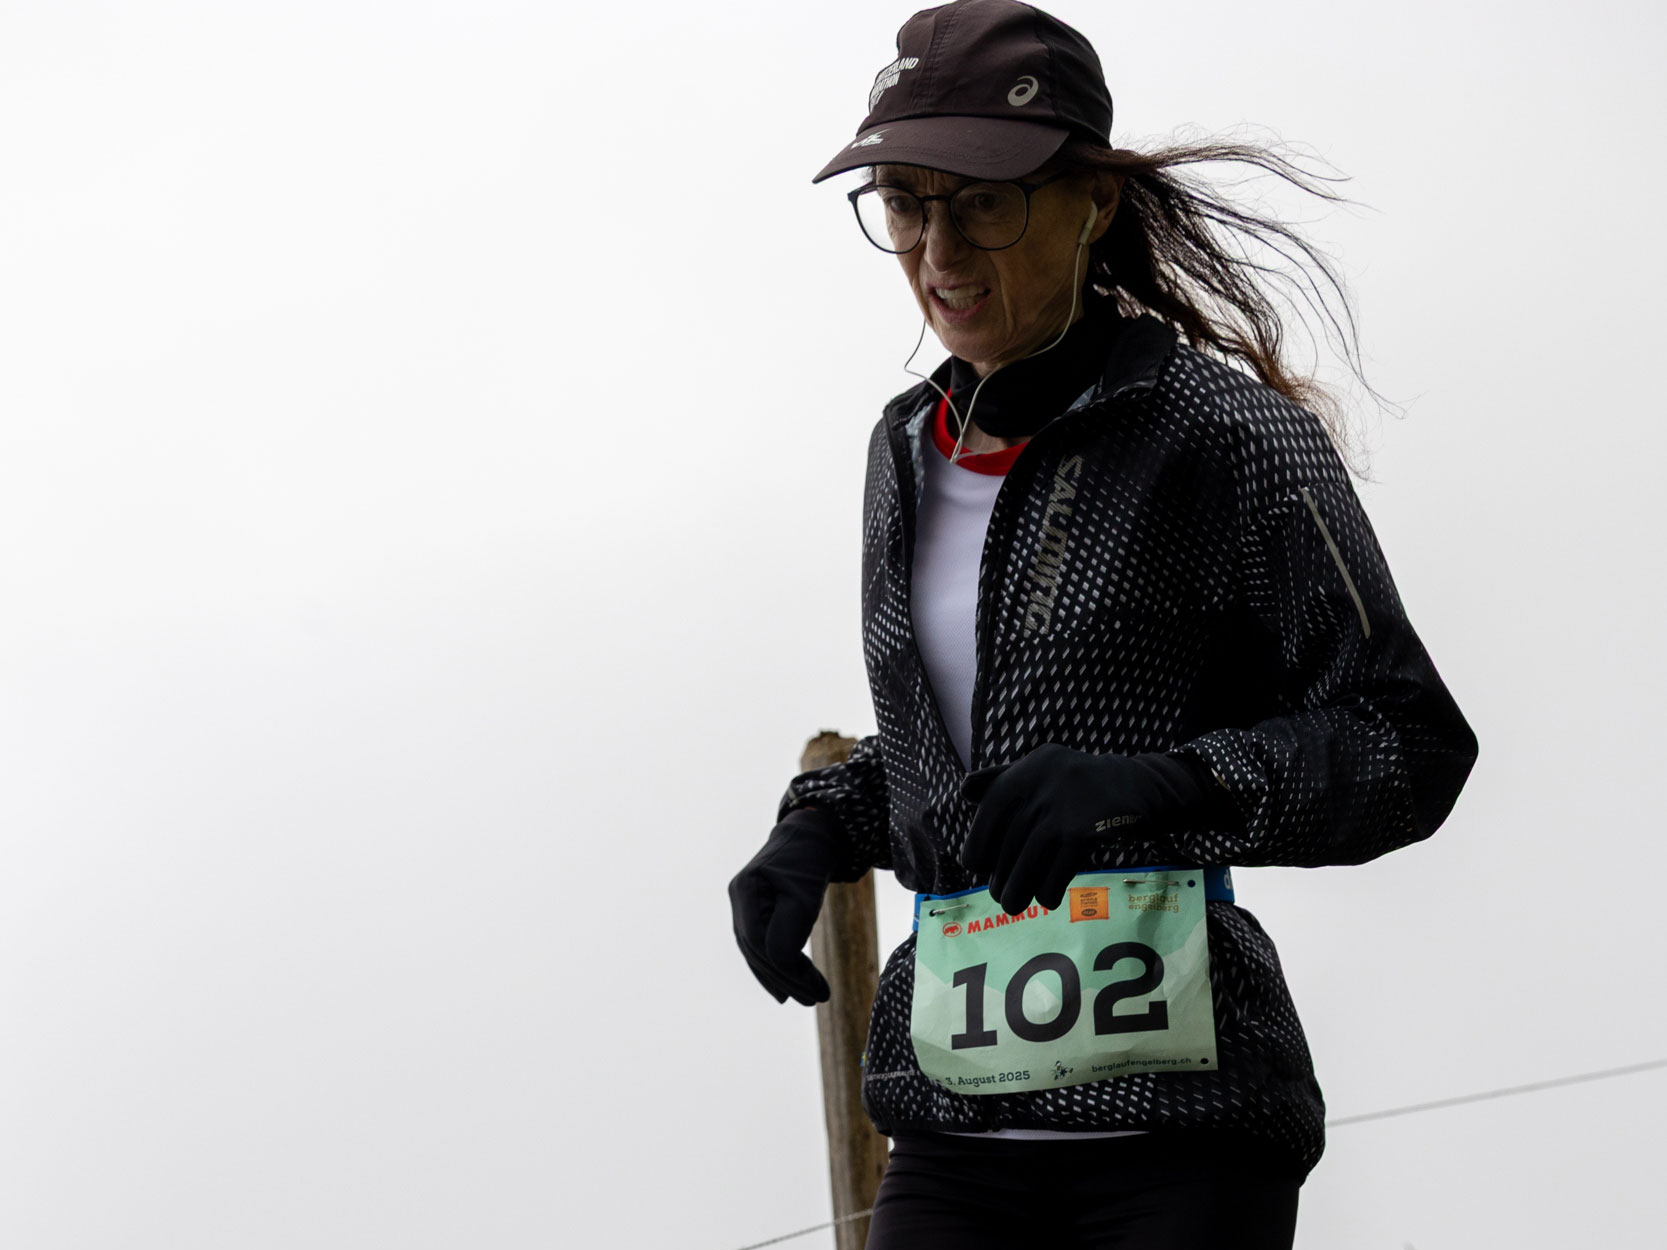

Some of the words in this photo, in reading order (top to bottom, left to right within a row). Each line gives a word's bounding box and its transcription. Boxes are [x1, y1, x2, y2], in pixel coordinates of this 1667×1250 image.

[1128, 894, 1179, 904] berglauf
[1128, 903, 1179, 913] engelberg
[951, 941, 1169, 1050] 102
[1091, 1057, 1192, 1073] berglaufengelberg.ch
[958, 1073, 997, 1088] August
[998, 1070, 1031, 1083] 2025
